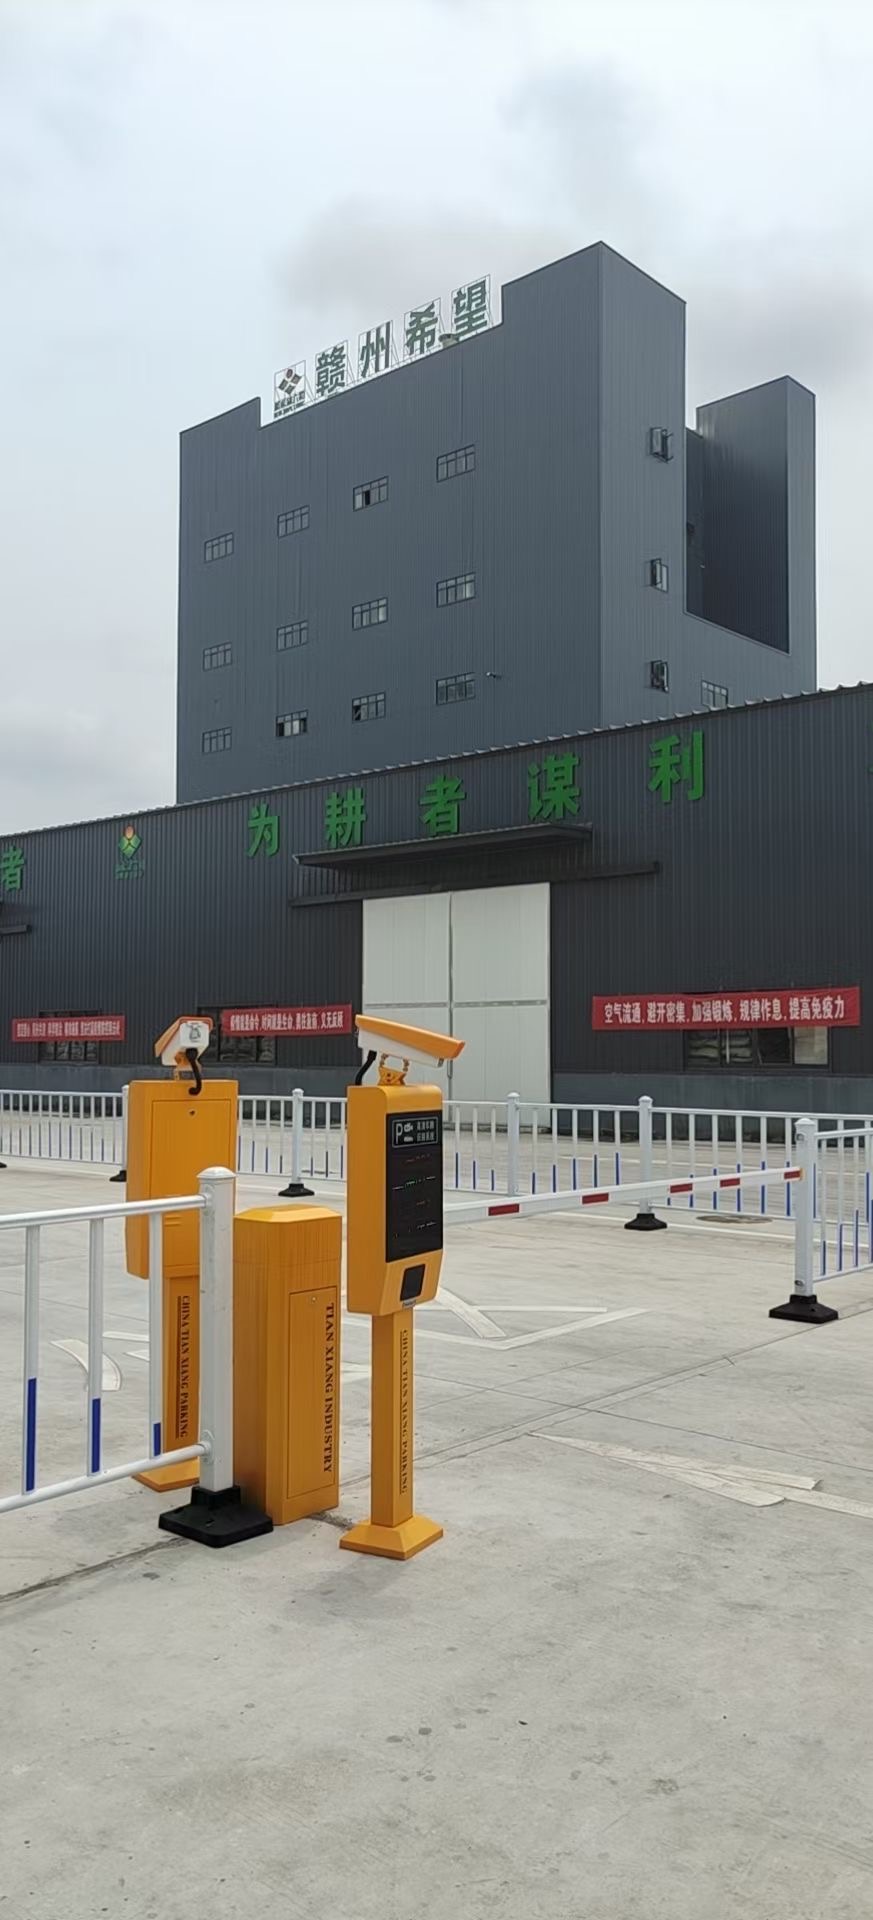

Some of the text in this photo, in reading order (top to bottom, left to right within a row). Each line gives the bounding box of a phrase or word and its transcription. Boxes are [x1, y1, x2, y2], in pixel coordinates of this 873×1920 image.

[315, 280, 487, 396] 赣州希望
[247, 731, 705, 857] 为耕者谋利
[179, 1296, 190, 1438] CHINA TIAN XIANG PARKING
[323, 1303, 335, 1473] TIAN XIANG INDUSTRY
